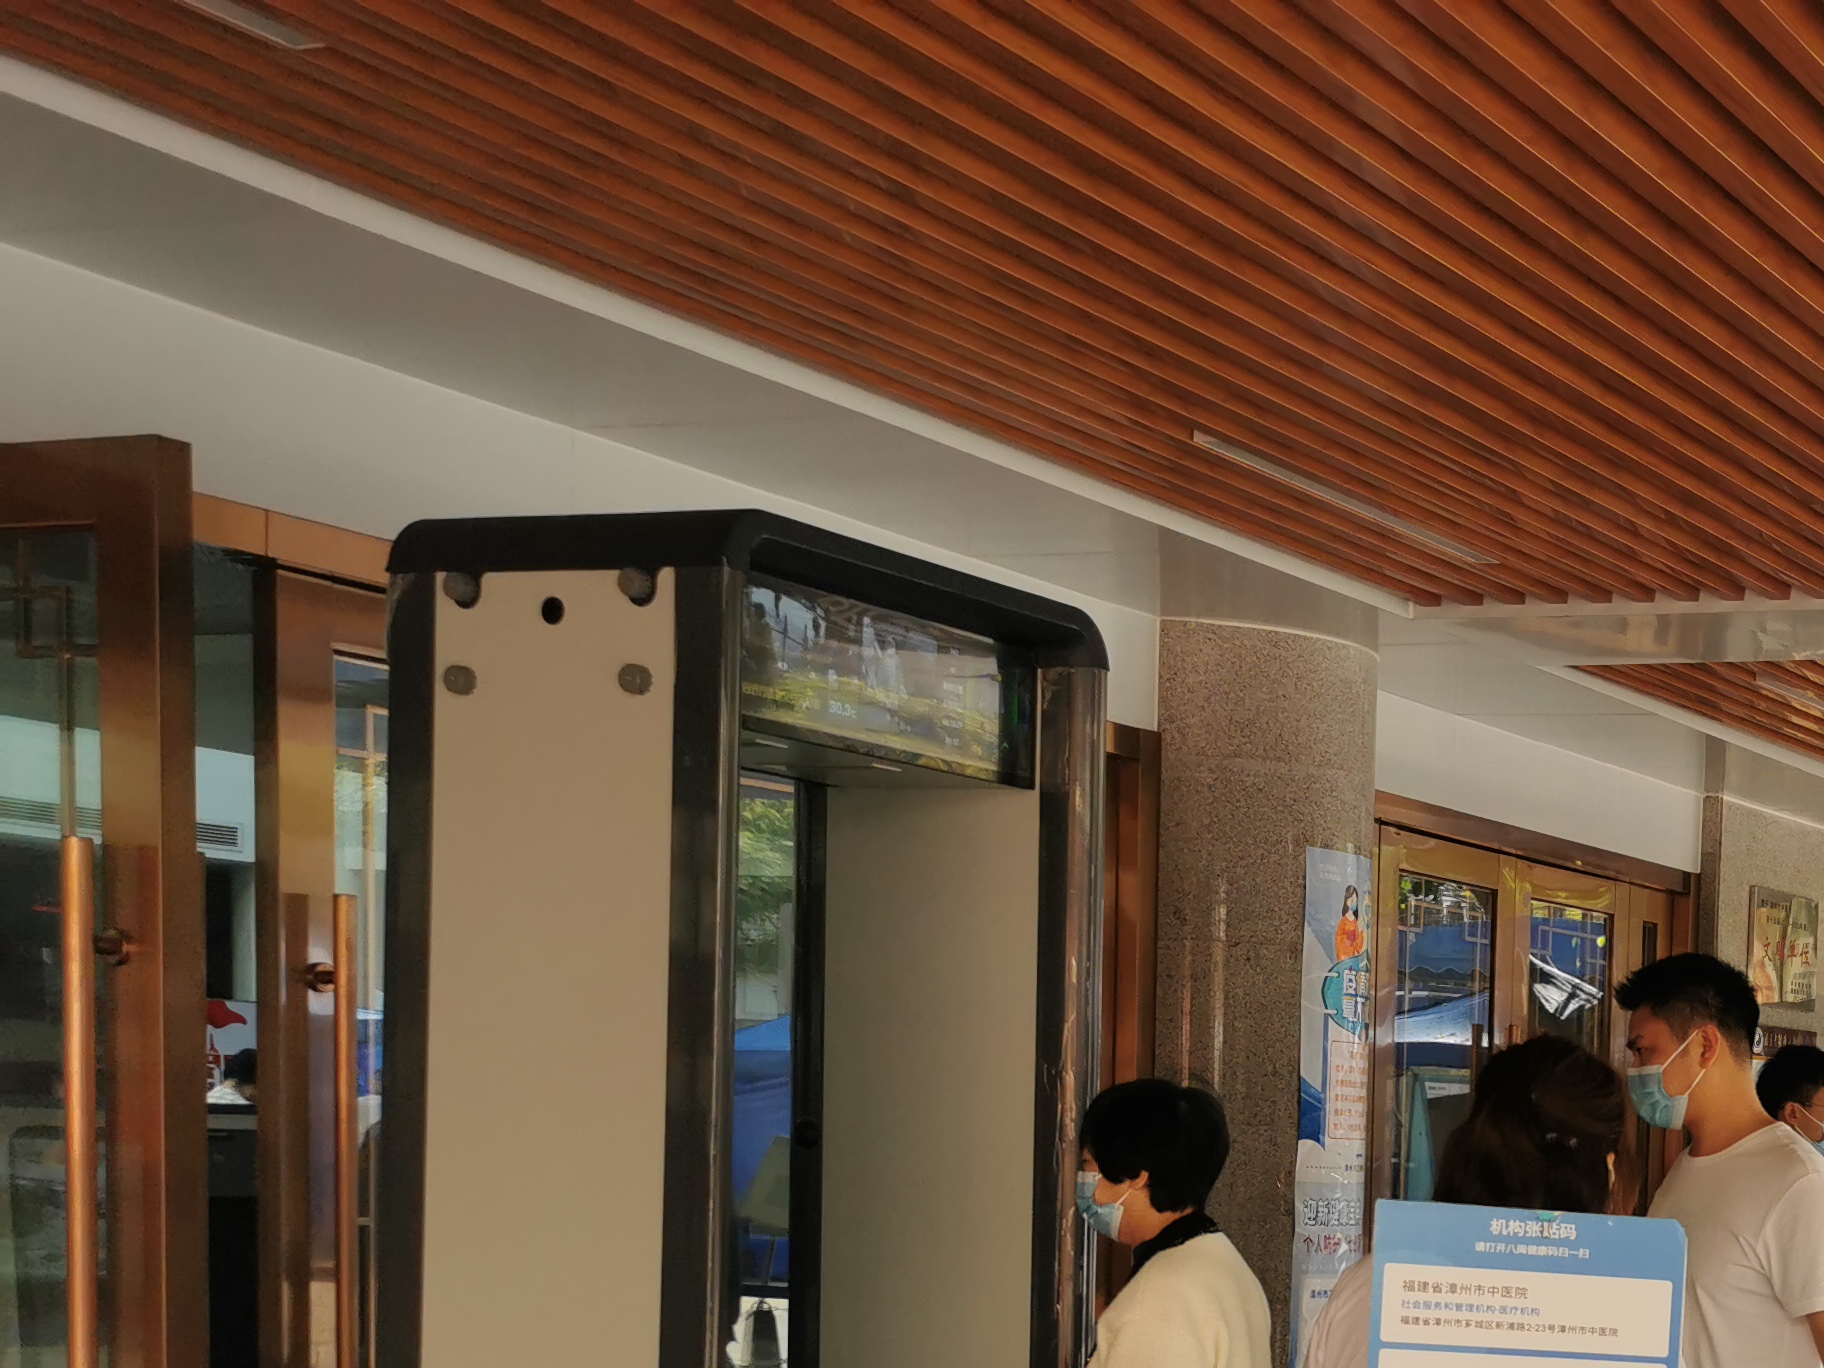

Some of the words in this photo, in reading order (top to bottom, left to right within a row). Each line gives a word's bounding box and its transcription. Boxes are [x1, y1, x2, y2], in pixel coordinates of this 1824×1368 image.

[1489, 1217, 1577, 1241] 机构张贴码
[1402, 1279, 1529, 1300] 福建省漳州市中医院
[1400, 1299, 1541, 1317] 社会服务和管理机构-医疗机构
